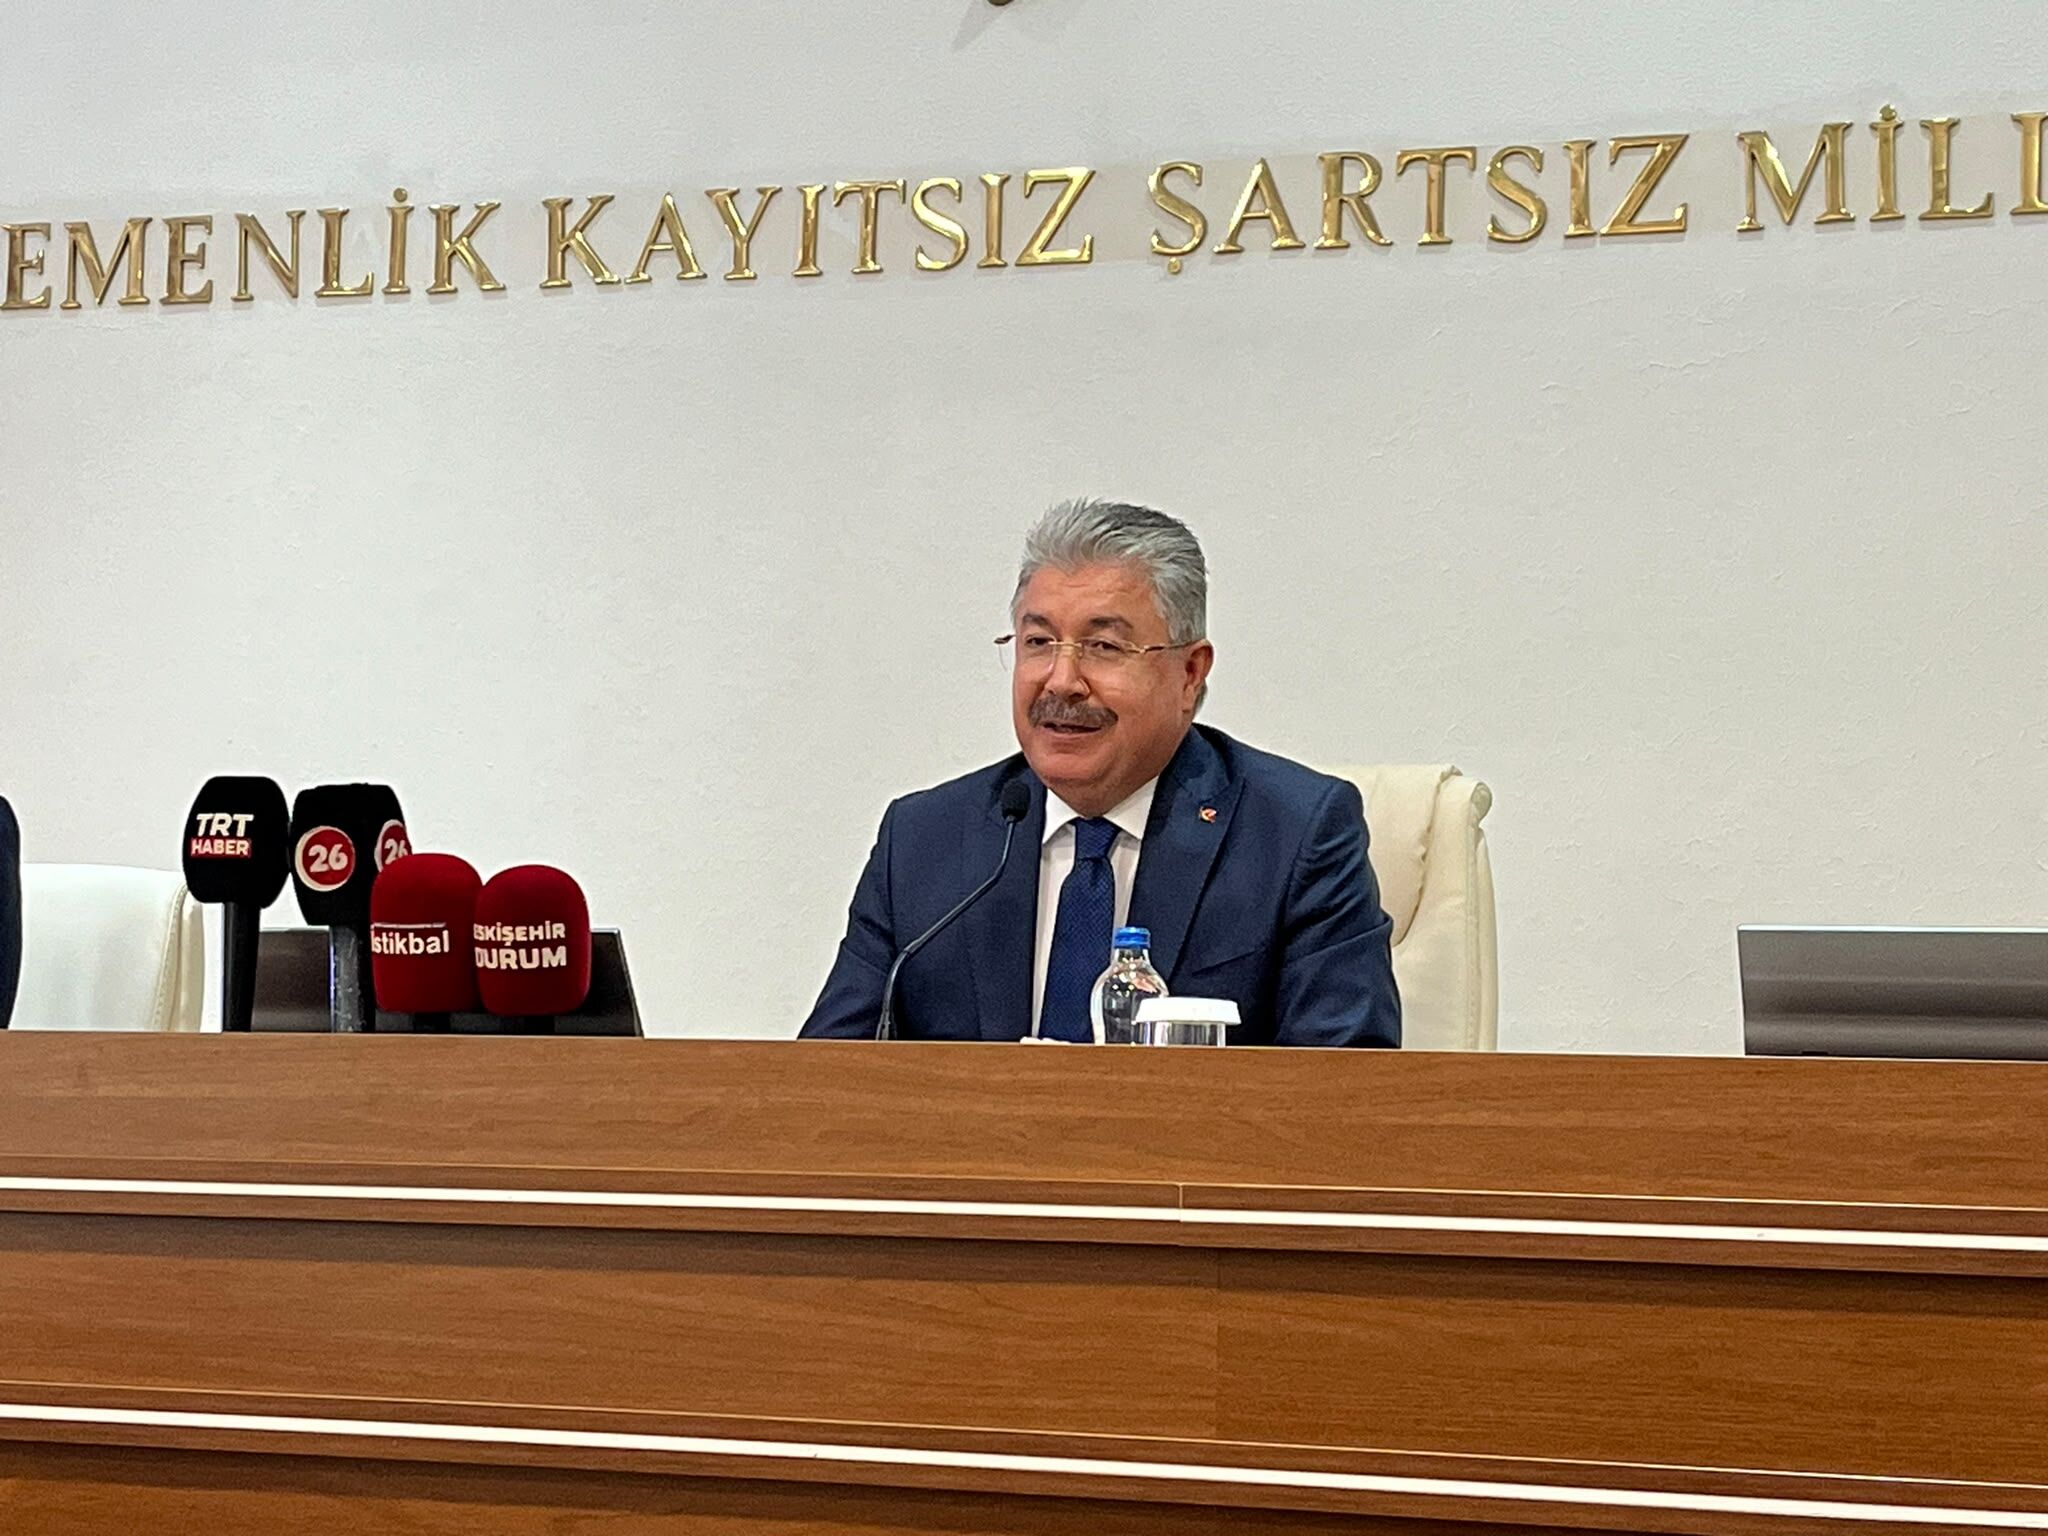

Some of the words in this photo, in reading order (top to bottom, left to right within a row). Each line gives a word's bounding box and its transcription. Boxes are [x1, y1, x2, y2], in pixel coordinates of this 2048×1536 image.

[0, 187, 505, 310] EMENLİK
[539, 164, 1095, 288] KAYITSIZ
[1146, 132, 1691, 275] ŞARTSIZ
[196, 812, 254, 837] TRT
[191, 838, 249, 855] HABER
[308, 844, 348, 873] 26
